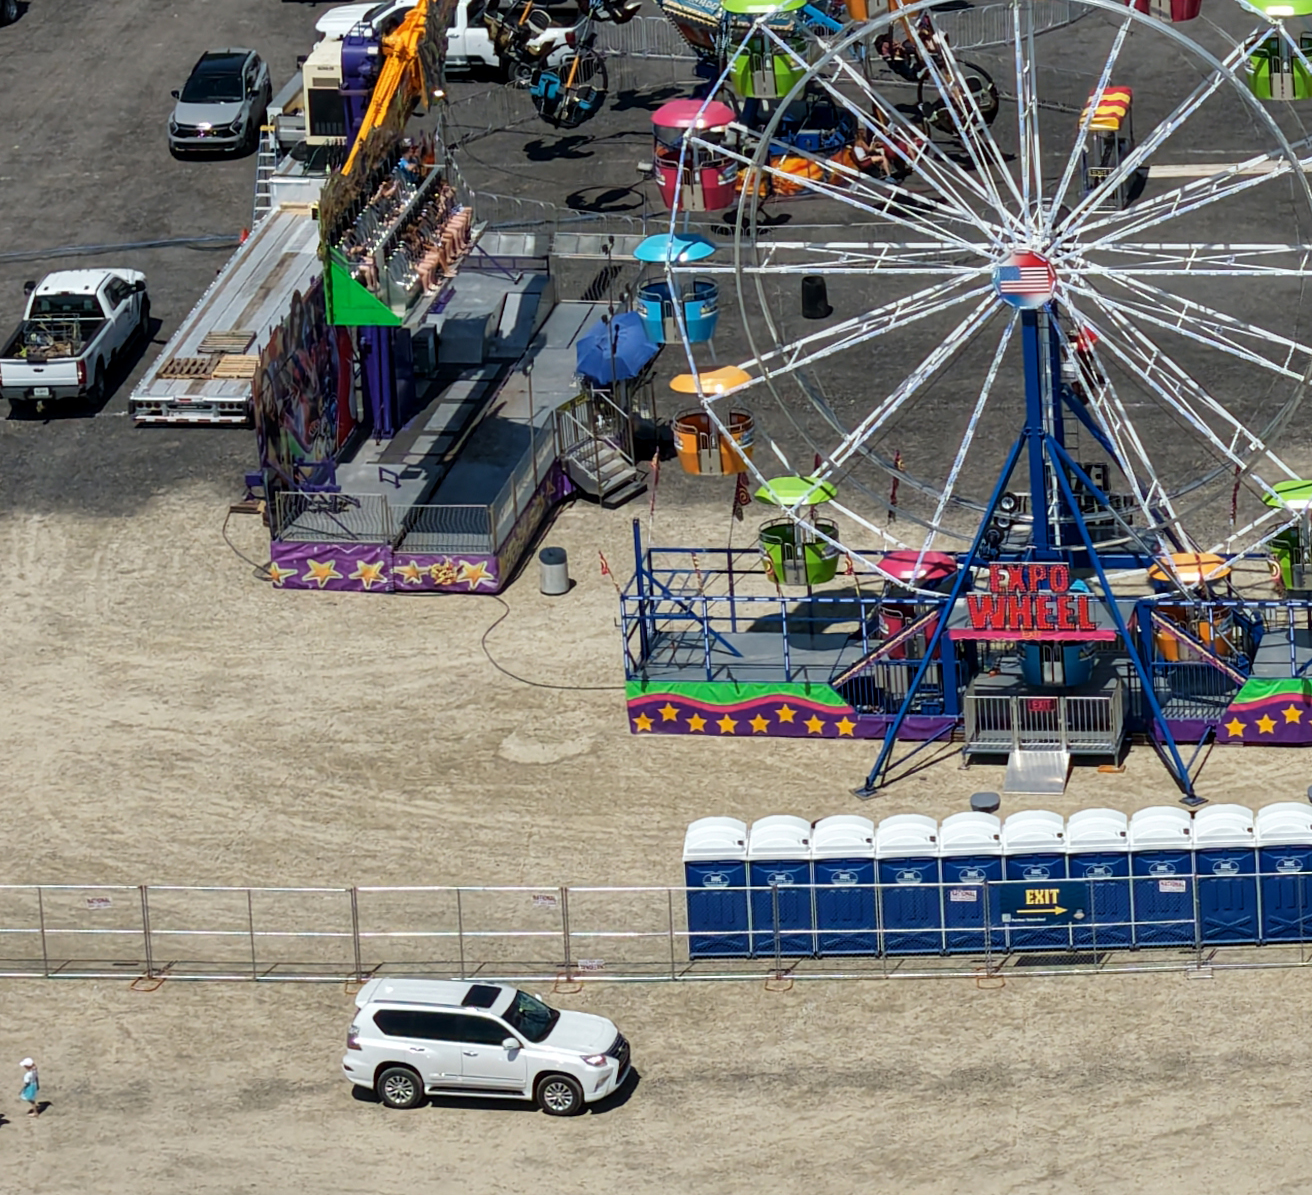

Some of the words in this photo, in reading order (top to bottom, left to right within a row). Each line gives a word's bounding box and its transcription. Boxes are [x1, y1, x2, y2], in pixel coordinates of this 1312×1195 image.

[988, 563, 1070, 593] EXPO
[966, 594, 1097, 630] WHEEL
[1025, 888, 1060, 905] EXIT
